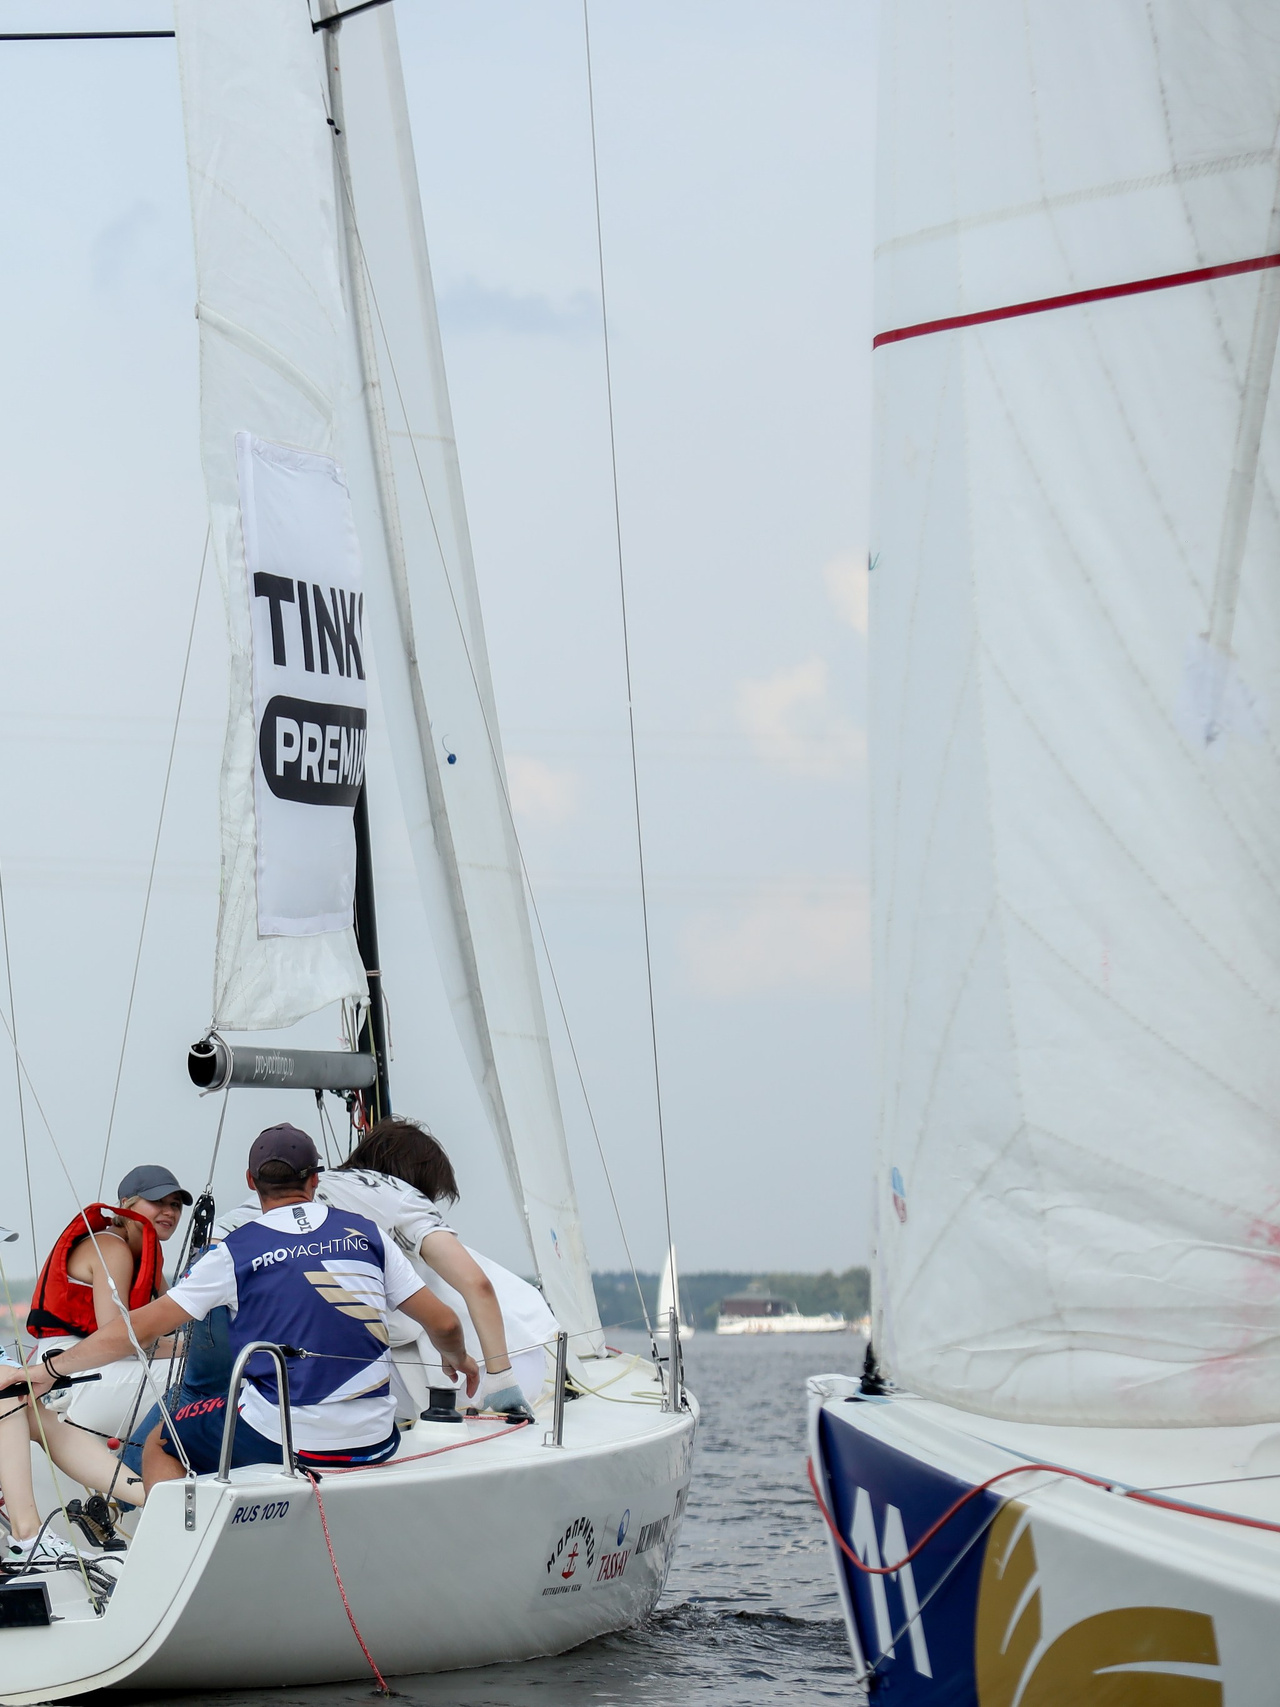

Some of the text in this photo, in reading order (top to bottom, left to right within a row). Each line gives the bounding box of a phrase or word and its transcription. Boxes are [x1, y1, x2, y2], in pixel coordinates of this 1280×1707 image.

[232, 1501, 290, 1524] RUS 1070
[597, 1549, 631, 1582] TASSAY
